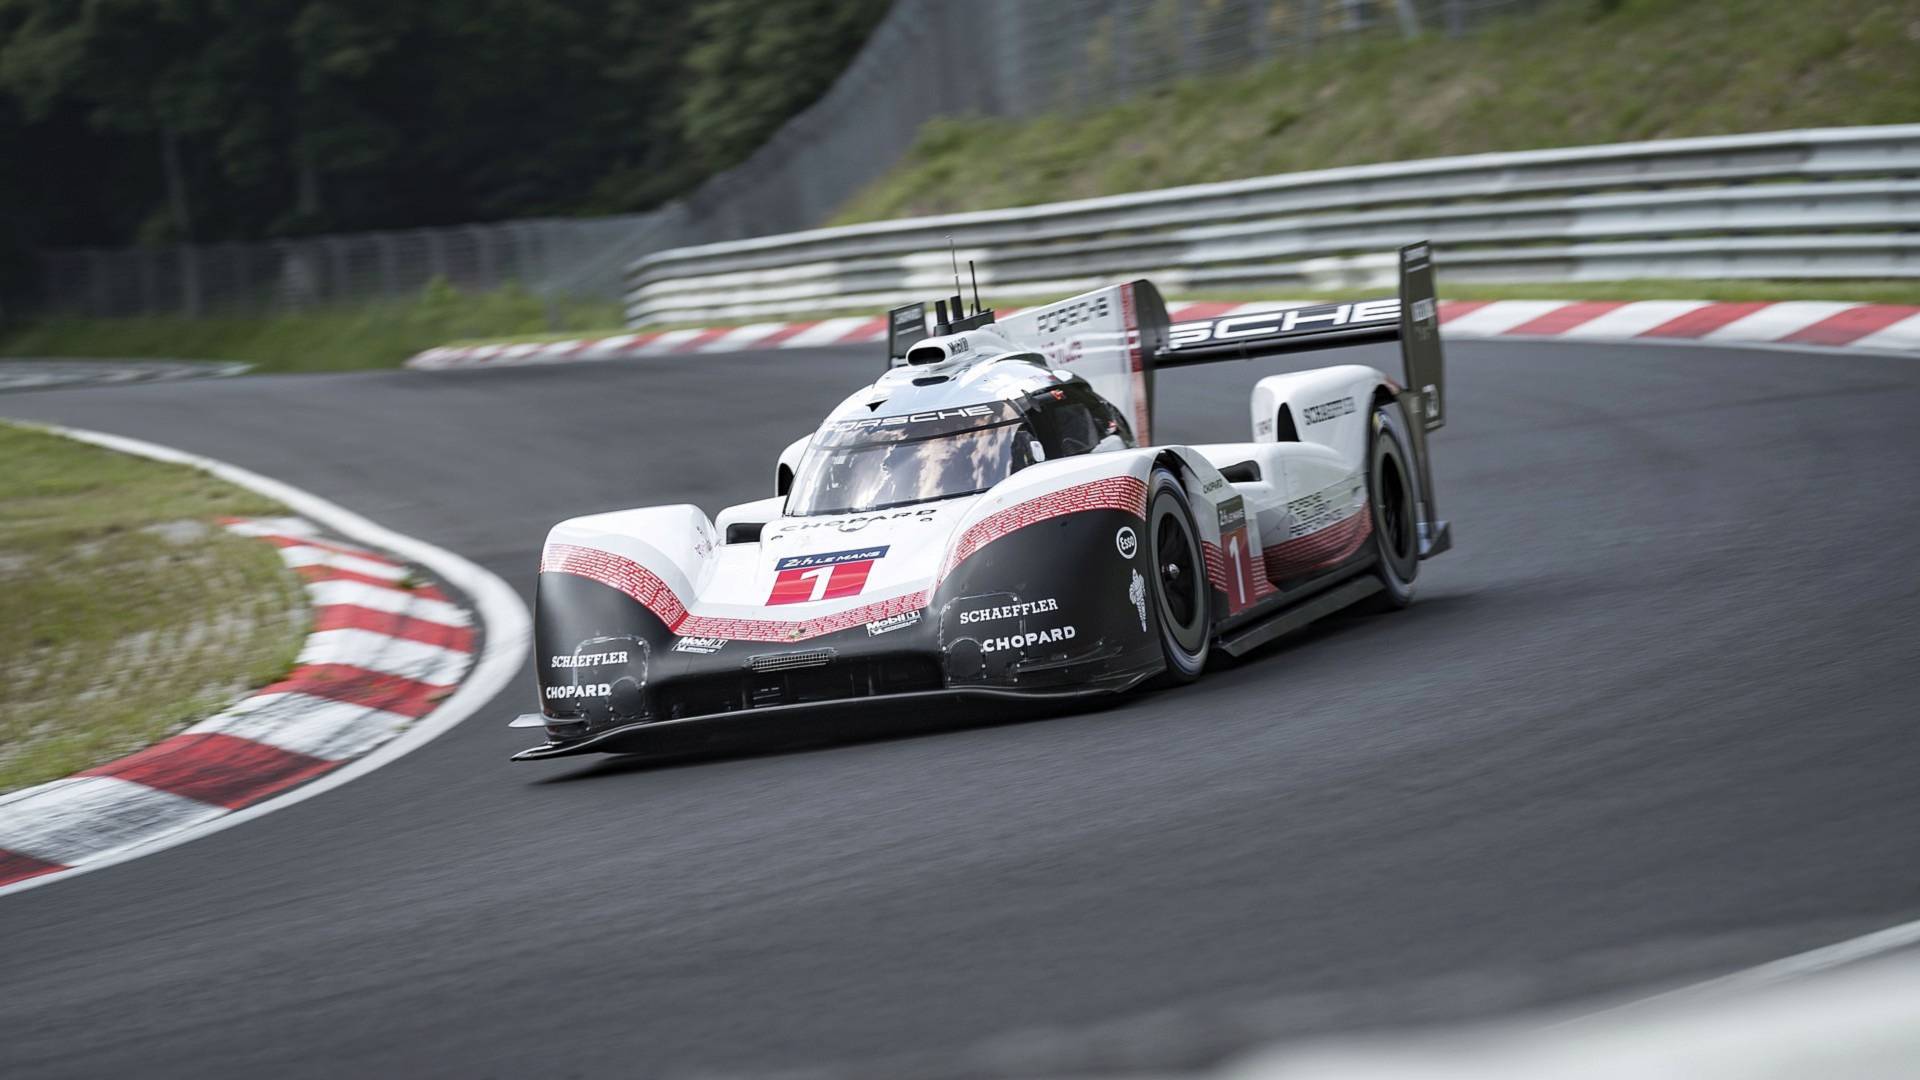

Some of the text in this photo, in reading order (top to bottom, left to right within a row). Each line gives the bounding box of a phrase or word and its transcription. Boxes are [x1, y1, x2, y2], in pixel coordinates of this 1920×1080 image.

[1037, 297, 1108, 335] PORSCHE
[1168, 299, 1401, 347] SCHE
[780, 509, 937, 532] CHOPARD
[1120, 535, 1135, 550] Esso
[837, 550, 881, 561] MANS
[1229, 535, 1246, 604] 1
[800, 565, 836, 601] 1
[866, 613, 905, 631] Mobil
[960, 598, 1059, 625] SCHAEFFLER
[678, 636, 716, 647] Mobil
[982, 626, 1076, 653] CHOPARD
[551, 651, 629, 668] SCHAEFFLER
[546, 683, 611, 699] CHOPARD
